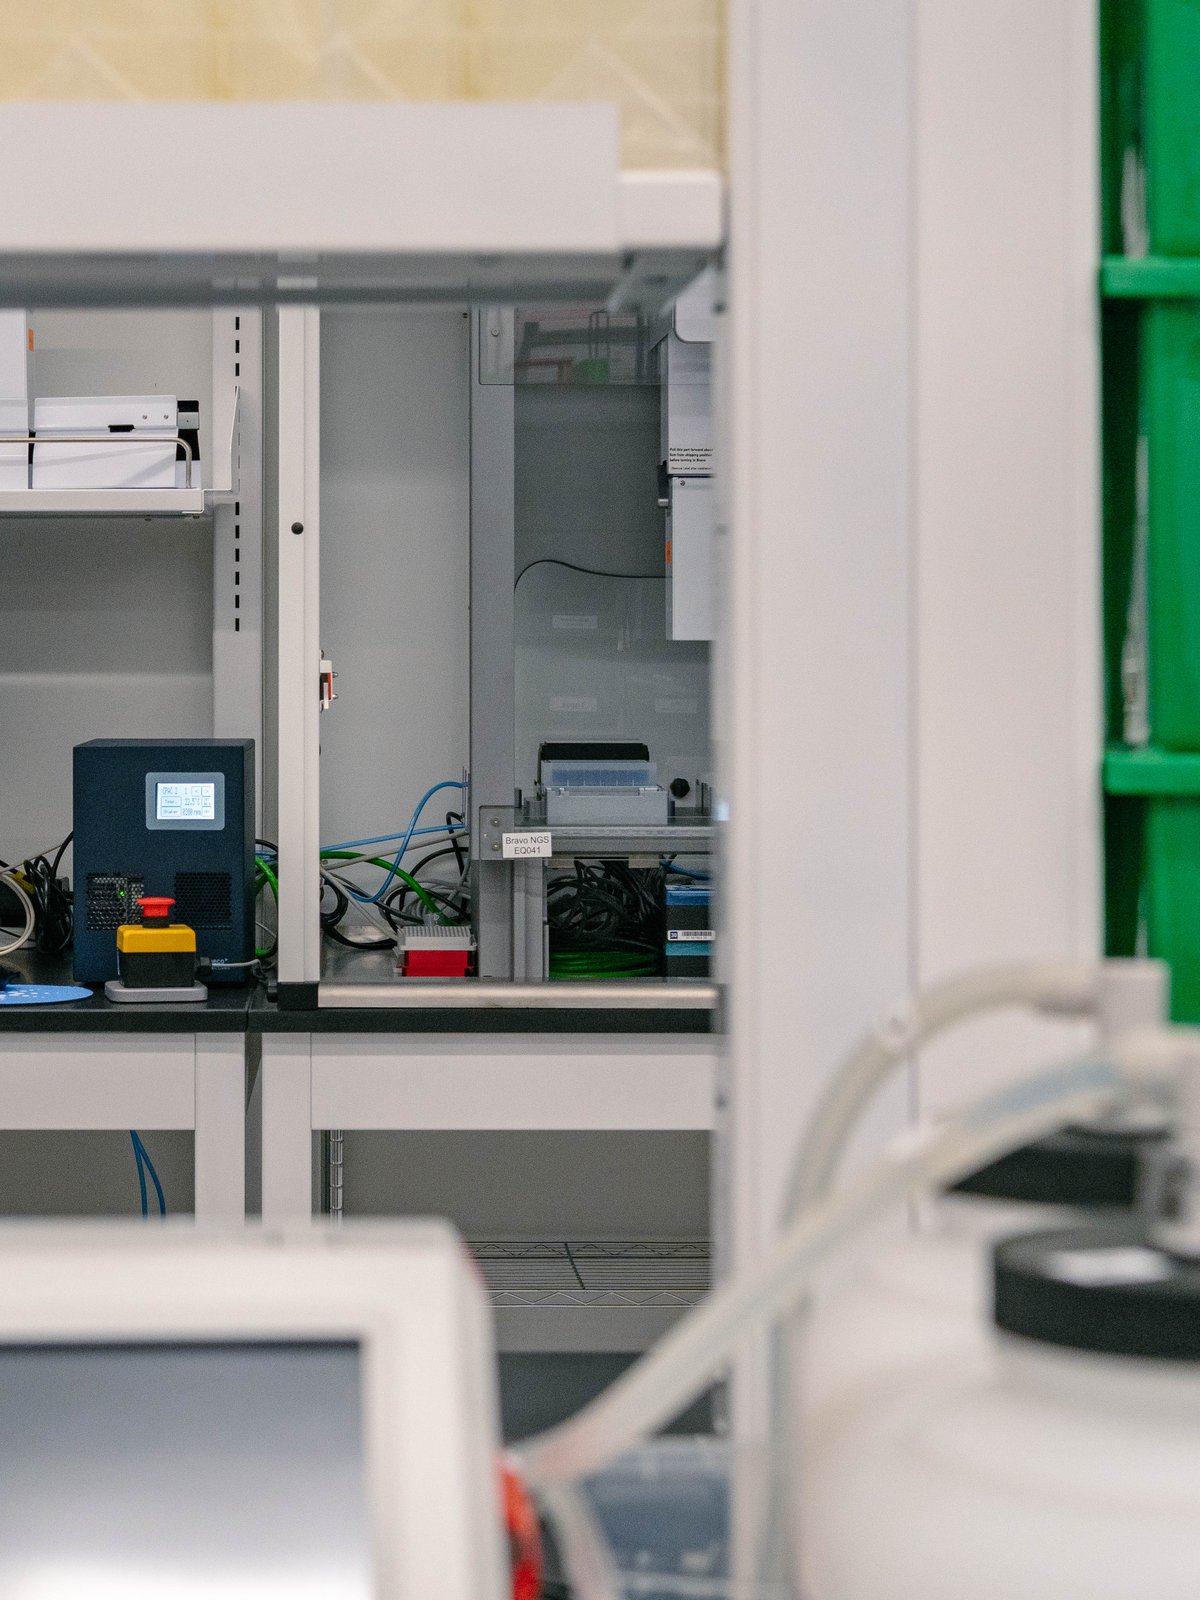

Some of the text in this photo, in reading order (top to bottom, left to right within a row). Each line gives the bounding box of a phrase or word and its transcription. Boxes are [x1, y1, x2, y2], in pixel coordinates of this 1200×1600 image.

[505, 835, 550, 844] Bravo NGS
[514, 846, 541, 855] EQ041
